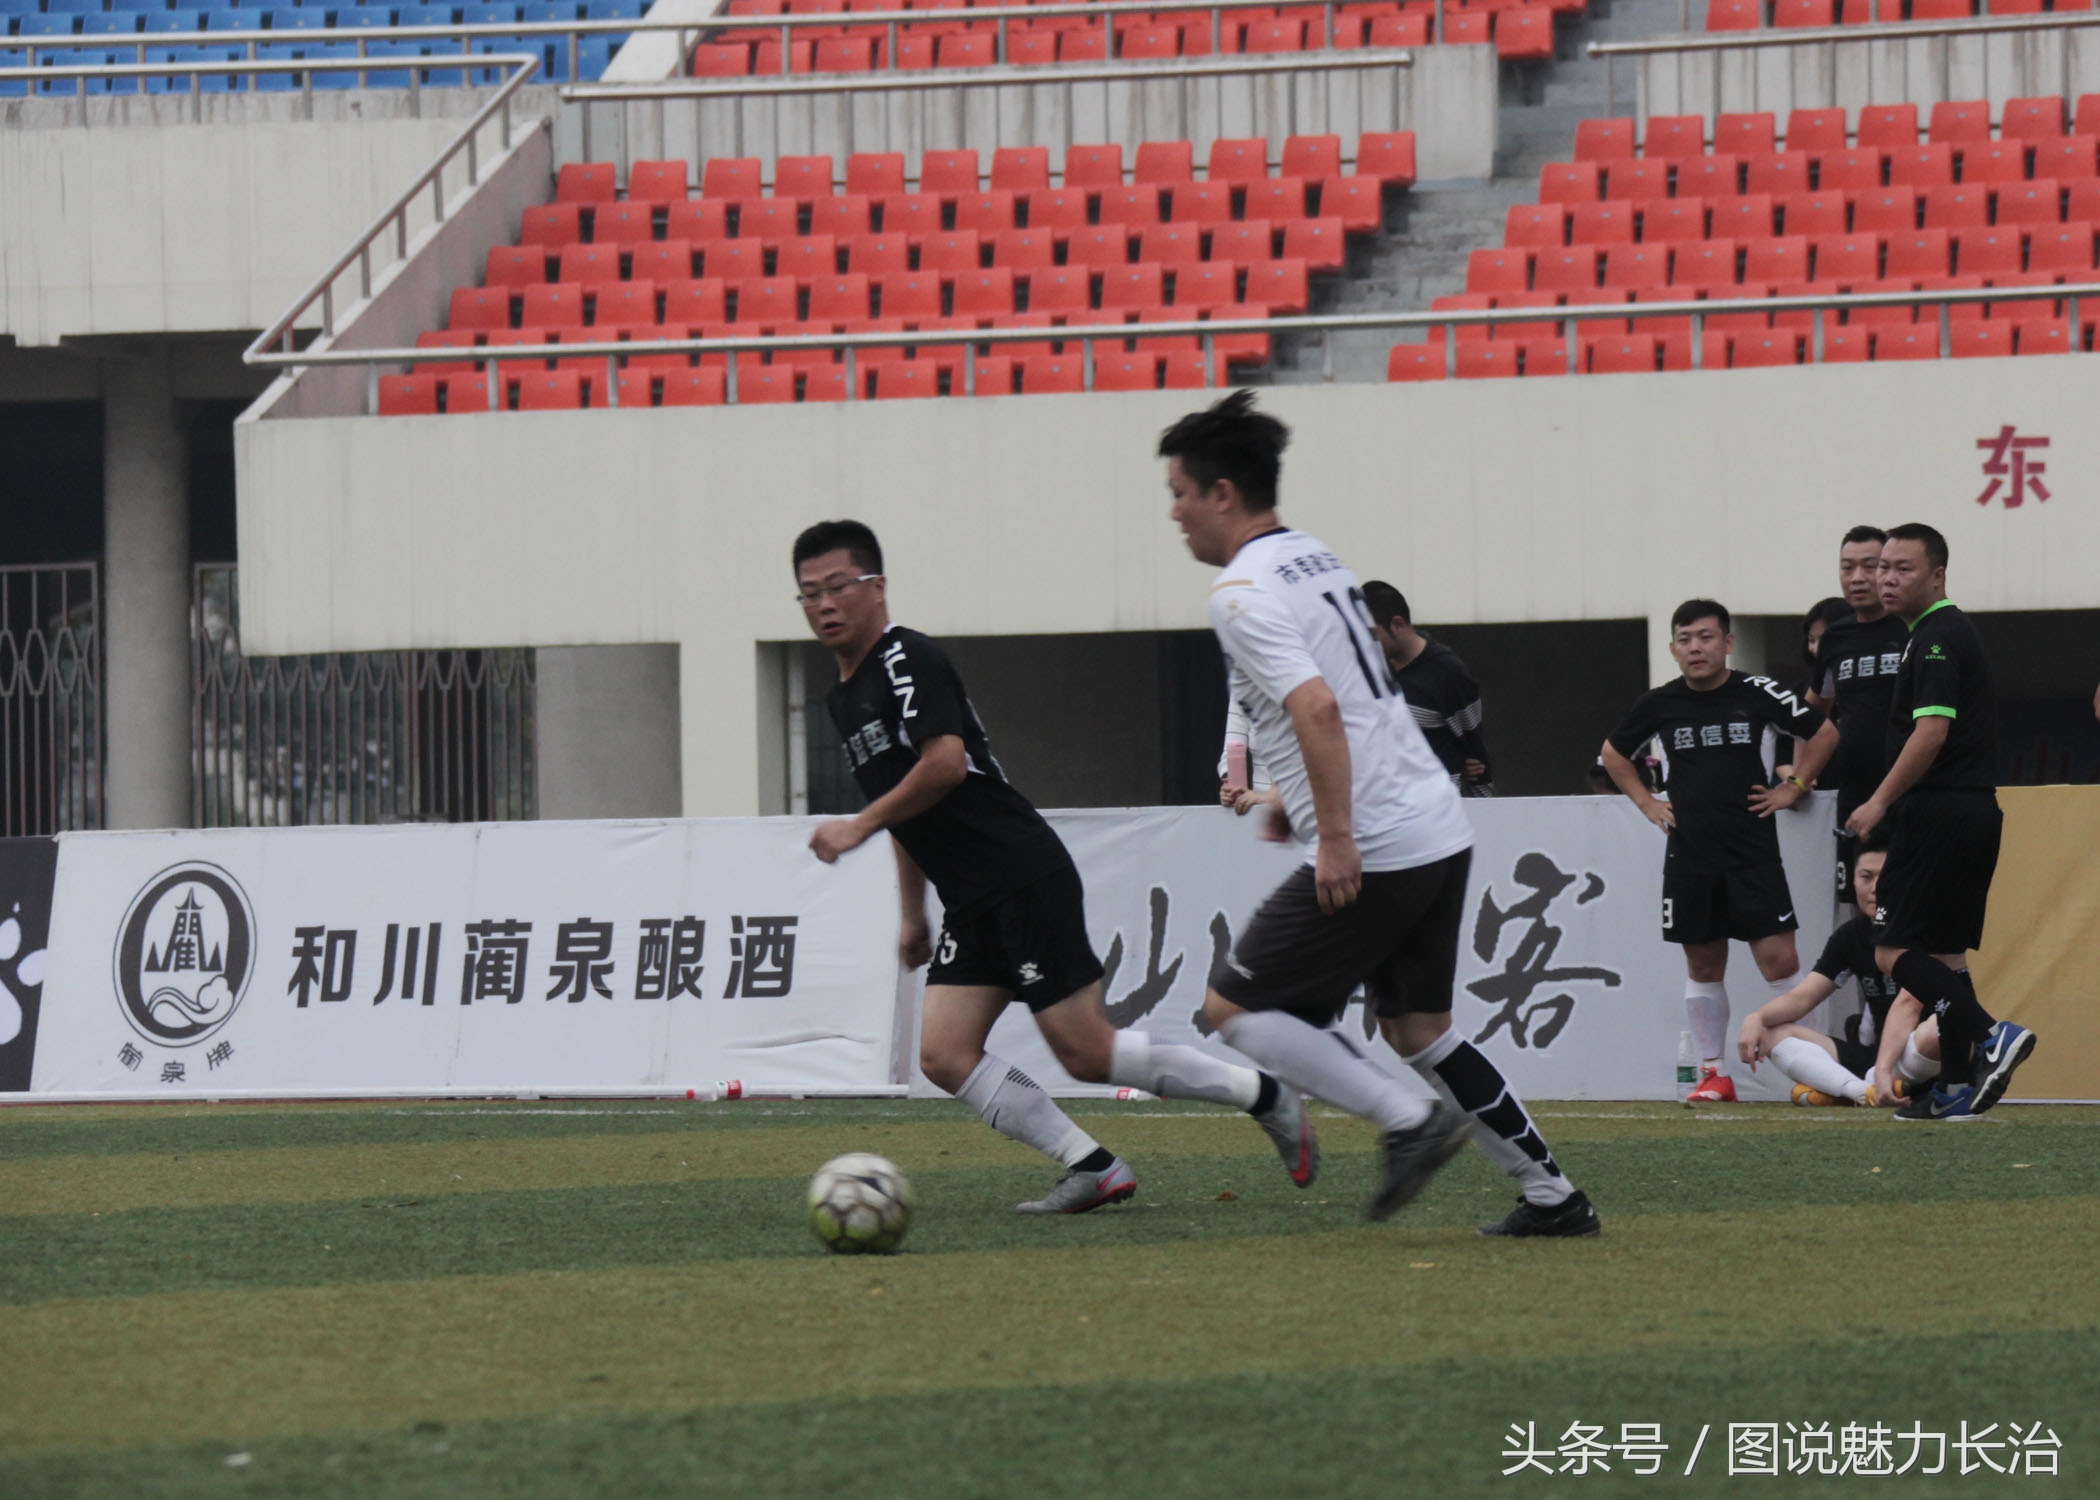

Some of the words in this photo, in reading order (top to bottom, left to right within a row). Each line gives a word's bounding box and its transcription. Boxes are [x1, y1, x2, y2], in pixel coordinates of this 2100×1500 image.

[1976, 425, 2051, 508] 东
[1743, 675, 1810, 718] RUN
[1673, 722, 1752, 750] 经信委
[287, 915, 799, 1008] 和川蔺泉酿酒
